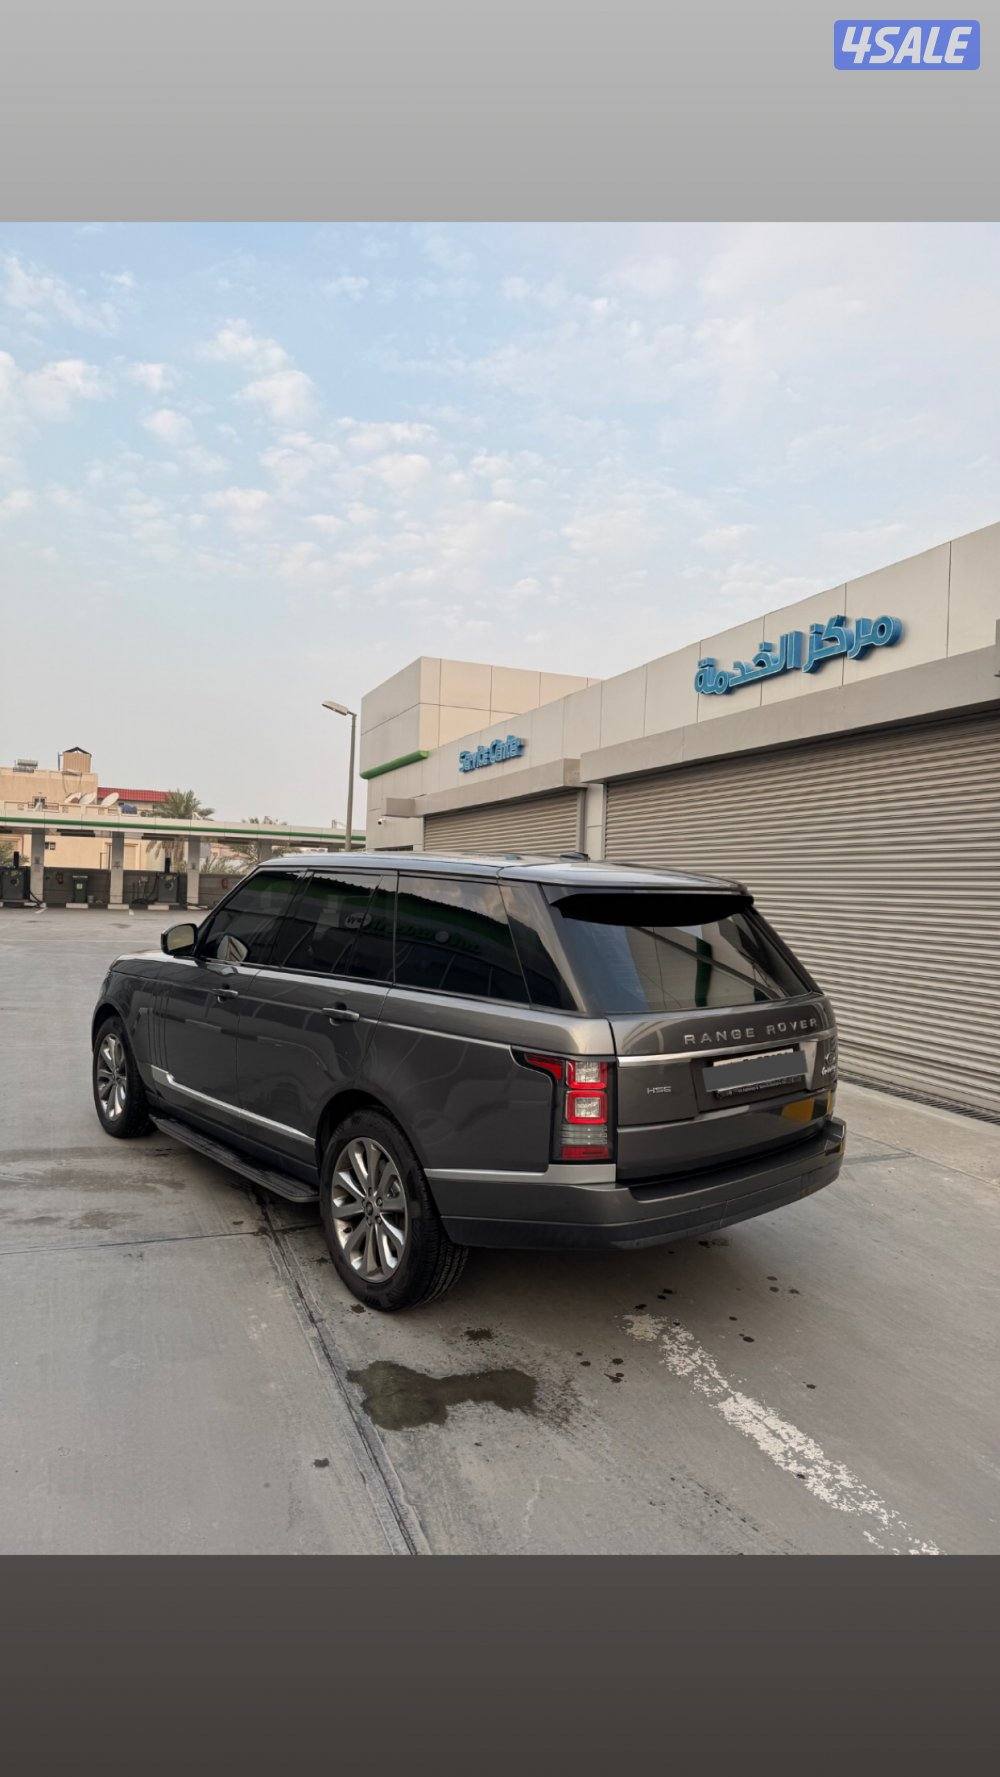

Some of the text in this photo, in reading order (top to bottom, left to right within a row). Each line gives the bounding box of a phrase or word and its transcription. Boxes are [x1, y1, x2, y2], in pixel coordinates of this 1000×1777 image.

[694, 614, 902, 695] مركز الخدمة
[459, 746, 490, 773] Service
[684, 1017, 818, 1046] RANGE ROVER
